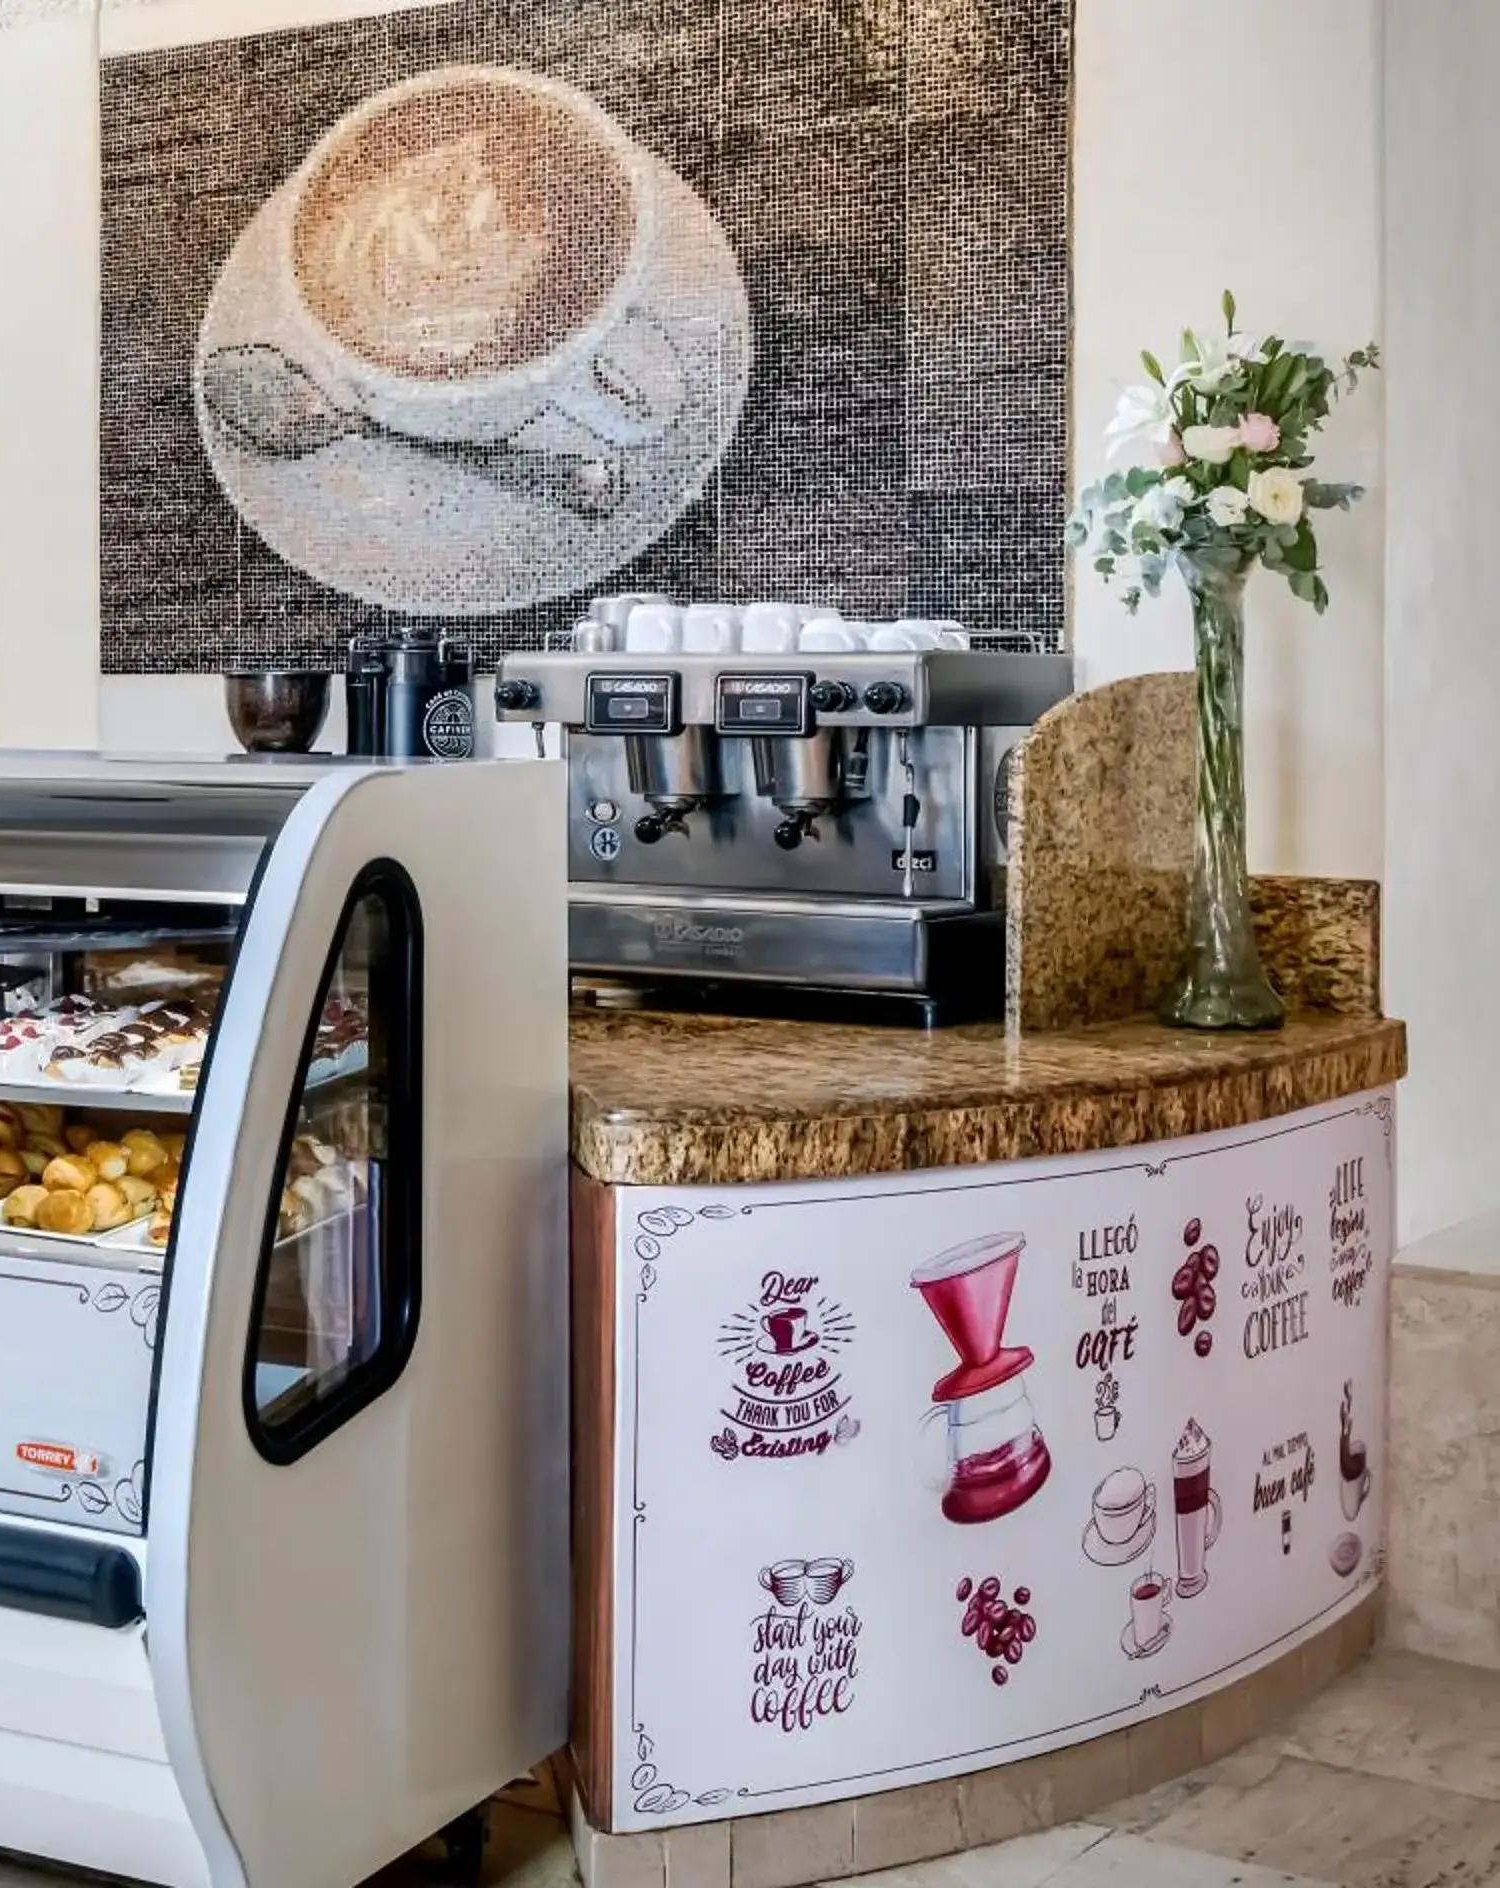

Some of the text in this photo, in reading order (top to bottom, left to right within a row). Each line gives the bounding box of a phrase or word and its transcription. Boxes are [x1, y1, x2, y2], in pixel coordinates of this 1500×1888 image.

[1079, 1213, 1138, 1261] LLEGÓ
[1246, 1194, 1302, 1267] Enjoy
[760, 1271, 819, 1306] Dear
[1072, 1260, 1130, 1297] la HORA
[1244, 1290, 1309, 1359] COFFEE
[746, 1356, 831, 1396] Coffee
[735, 1389, 840, 1426] THANK YOU FOR
[741, 1430, 833, 1458] Existing
[1290, 1445, 1315, 1503] café
[750, 1601, 862, 1656] start your
[754, 1638, 859, 1688] day with
